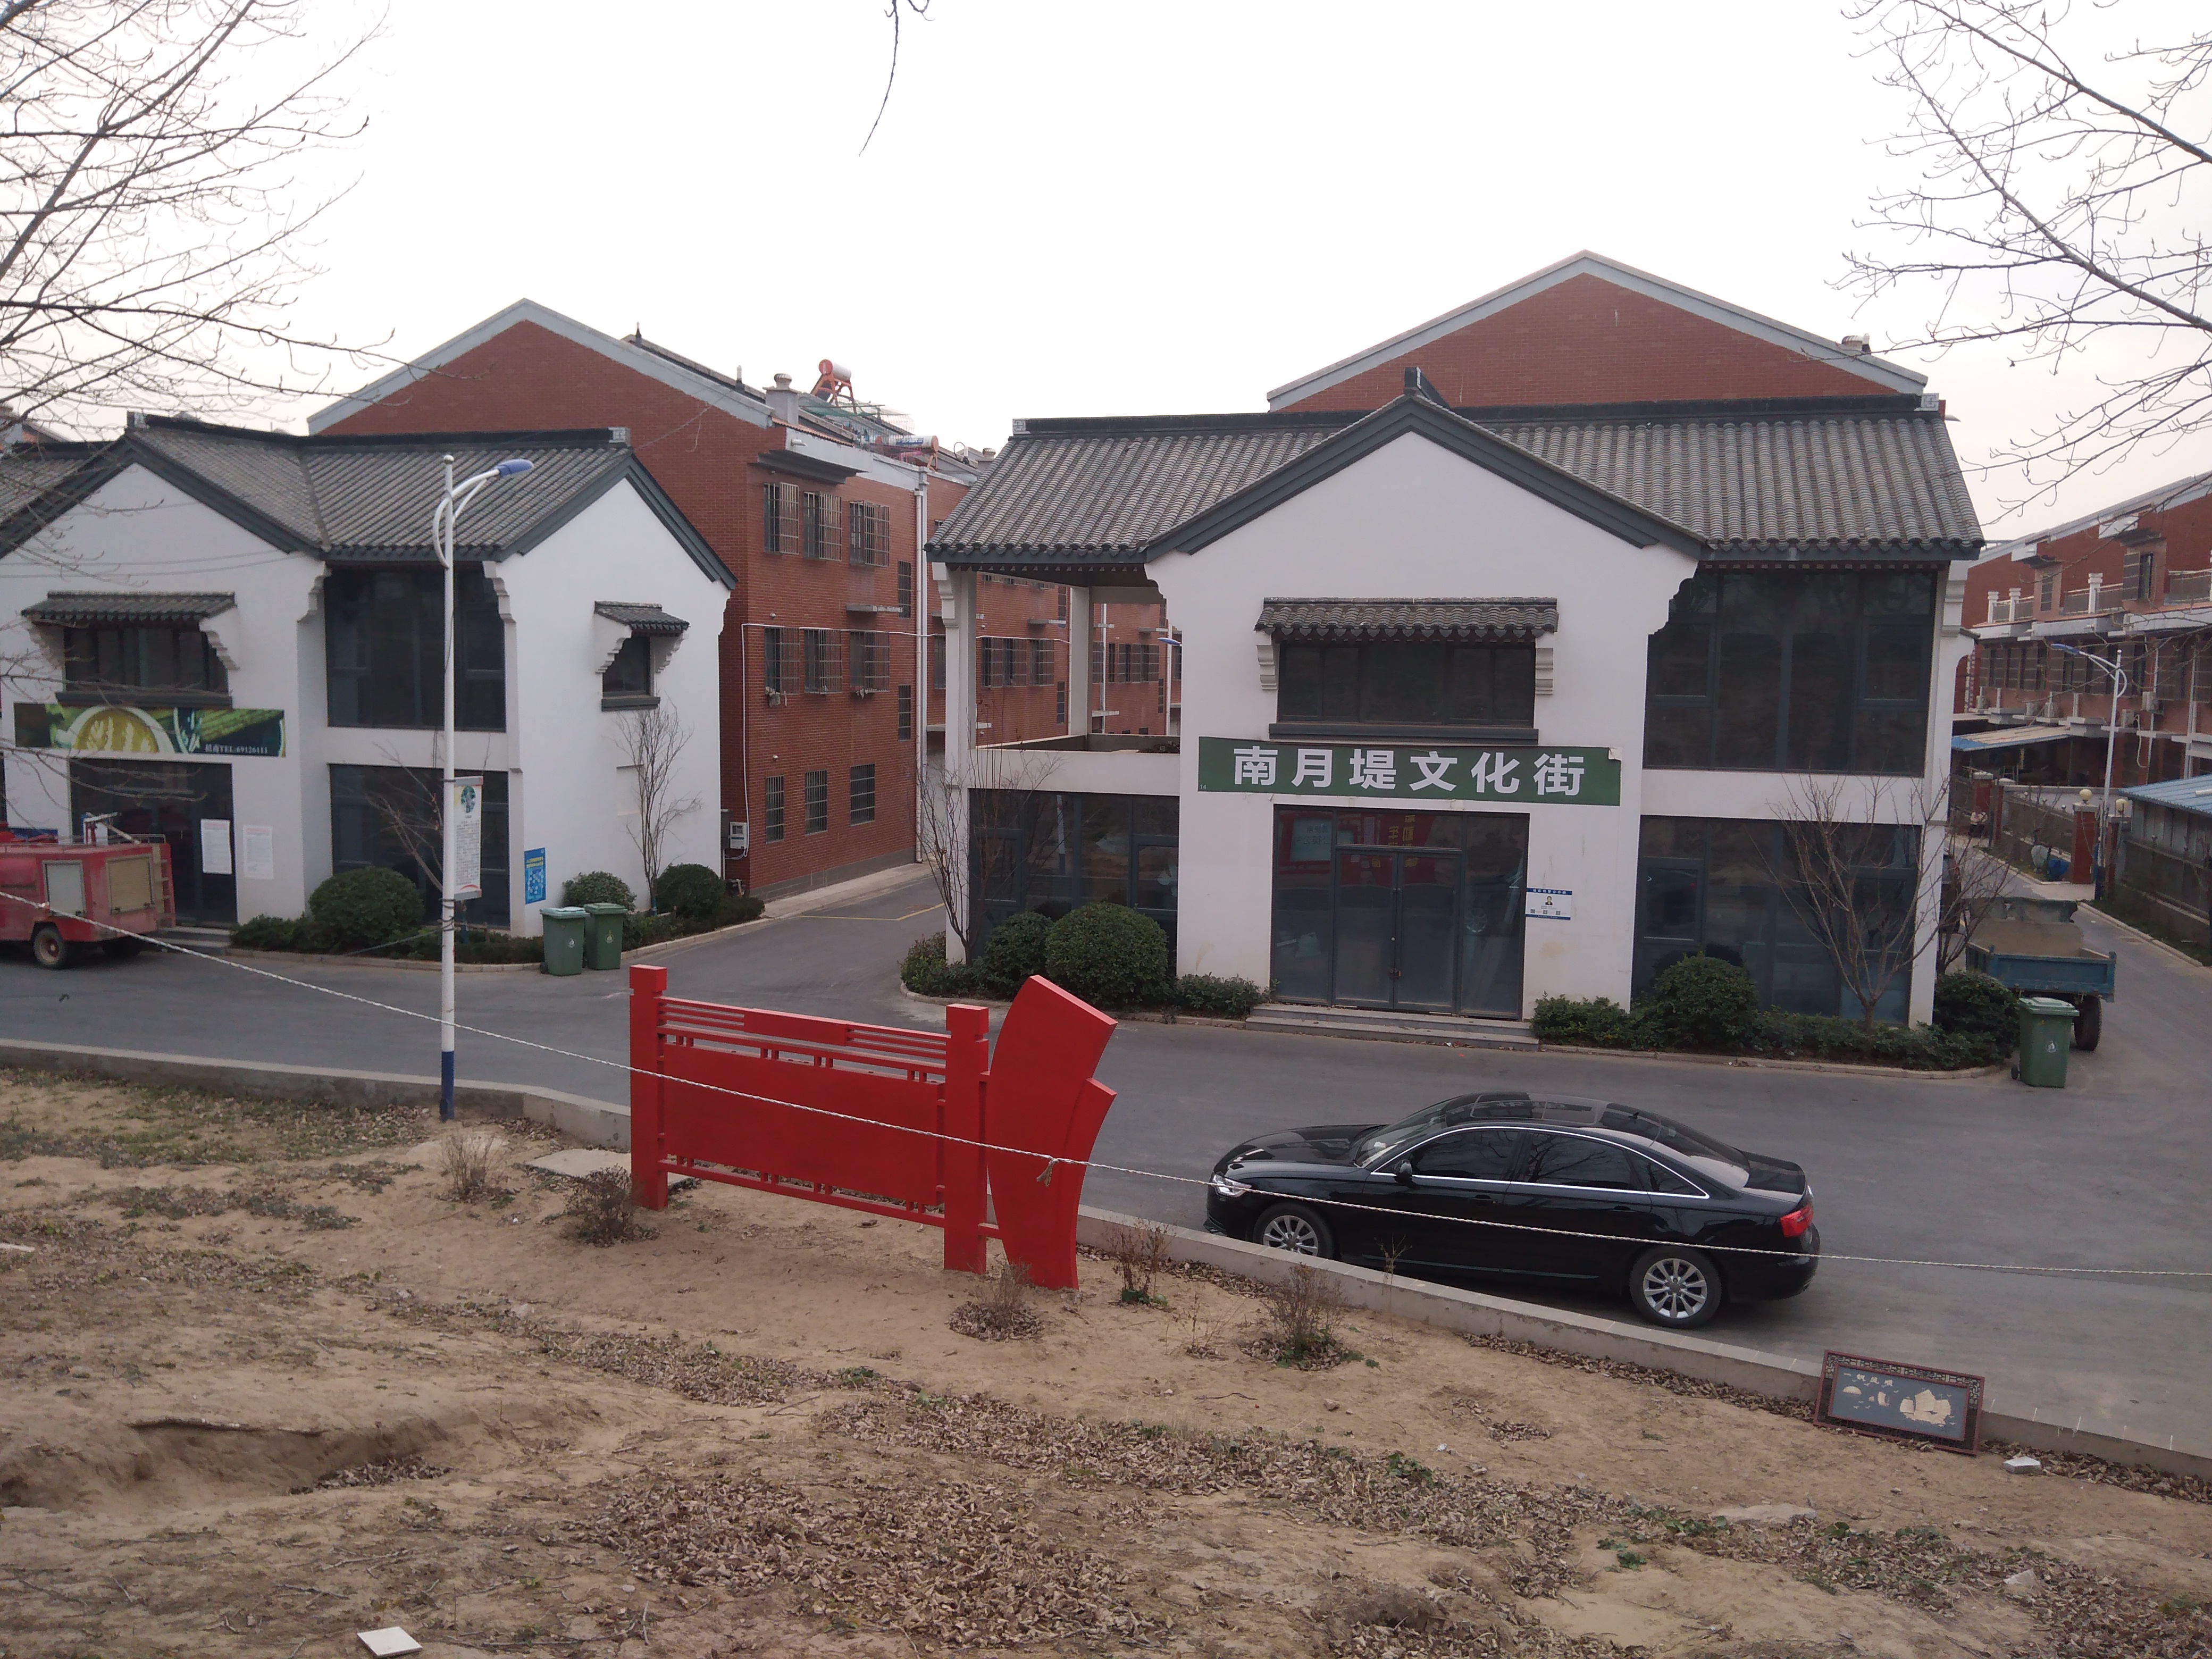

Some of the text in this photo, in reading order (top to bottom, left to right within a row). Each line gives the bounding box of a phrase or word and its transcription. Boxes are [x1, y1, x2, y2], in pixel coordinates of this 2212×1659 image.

[1233, 745, 1585, 795] 南月堤文化街
